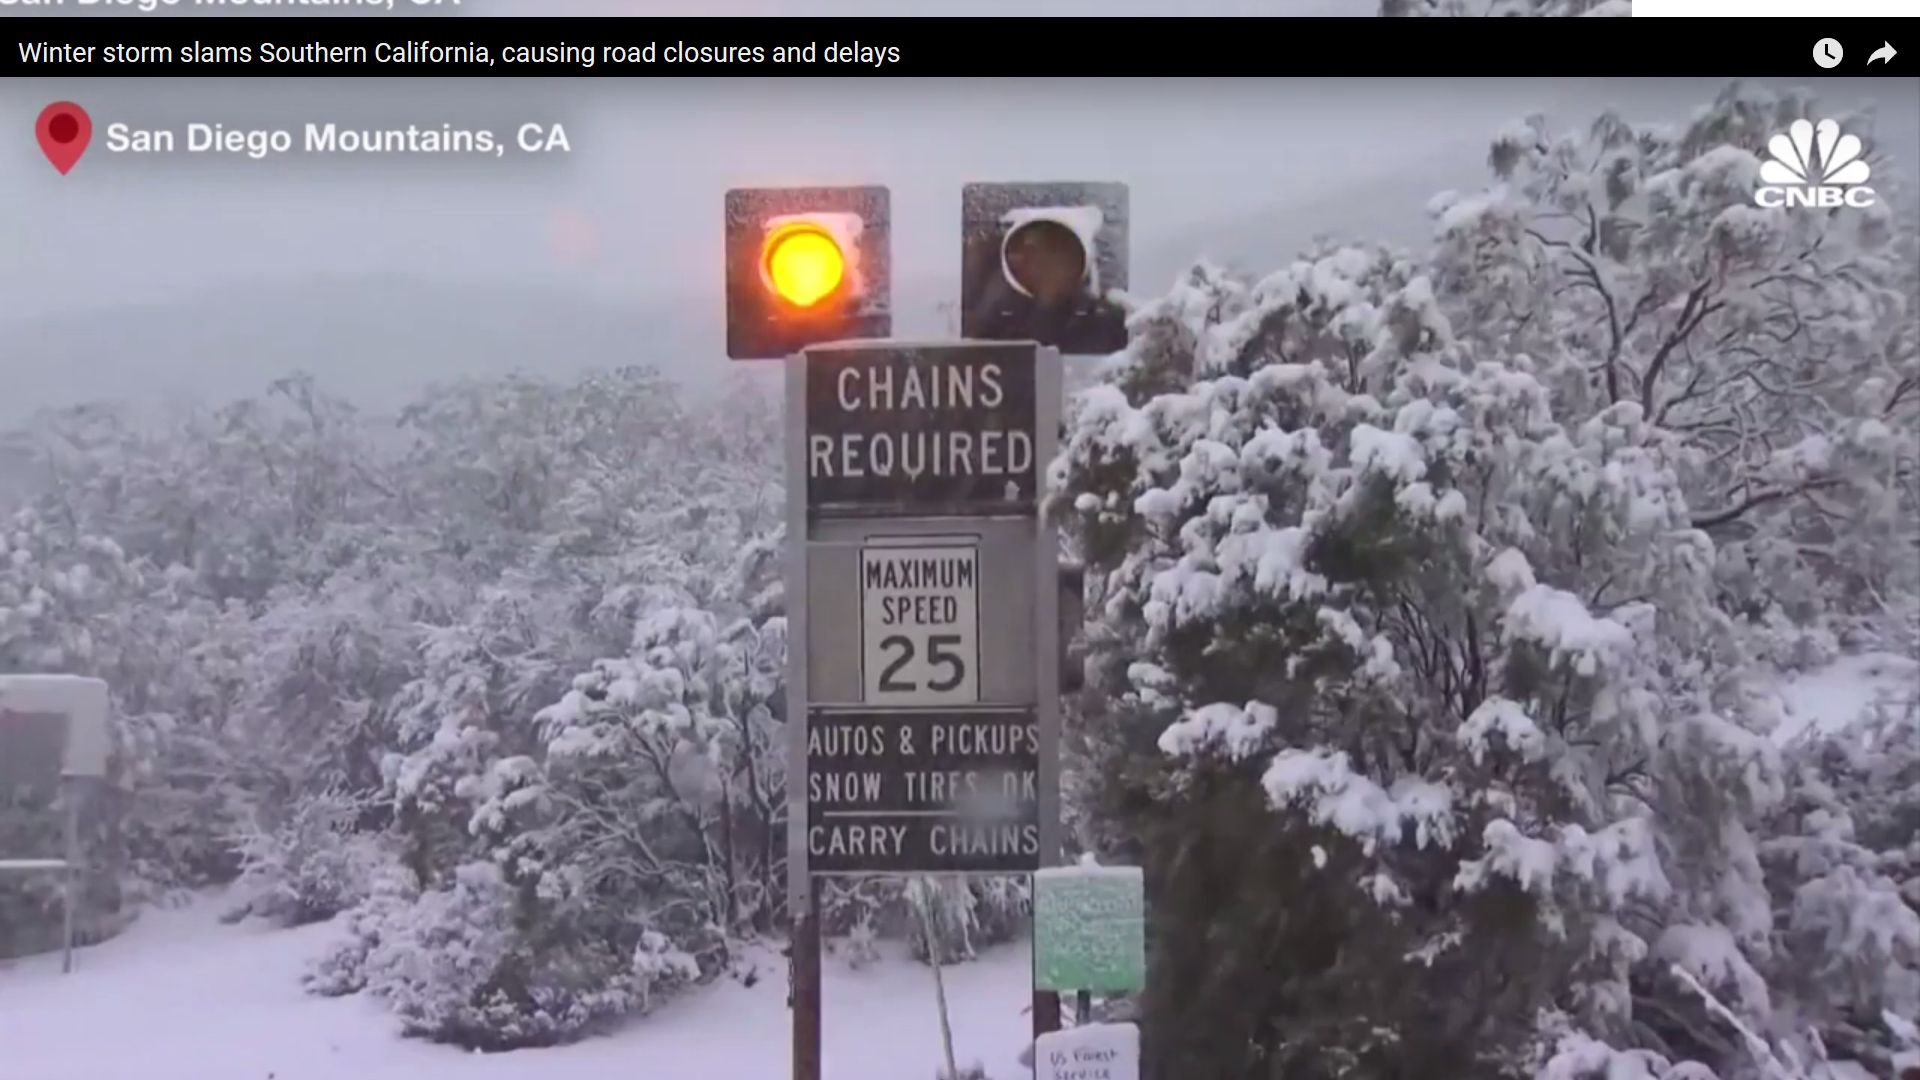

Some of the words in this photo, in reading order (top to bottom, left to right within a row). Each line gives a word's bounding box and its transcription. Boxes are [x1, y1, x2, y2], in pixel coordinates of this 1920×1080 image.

[837, 363, 1003, 411] CHAINS
[810, 430, 1033, 478] REQUIRED
[866, 558, 972, 590] MAXIMUM
[882, 595, 957, 625] SPEED
[878, 635, 965, 692] 25
[808, 725, 884, 757] AUTOS
[899, 725, 915, 756] &
[931, 724, 1039, 756] PICKUPS
[809, 772, 881, 802] SNOW
[809, 825, 907, 856] CARRY
[930, 823, 1039, 856] CHAINS
